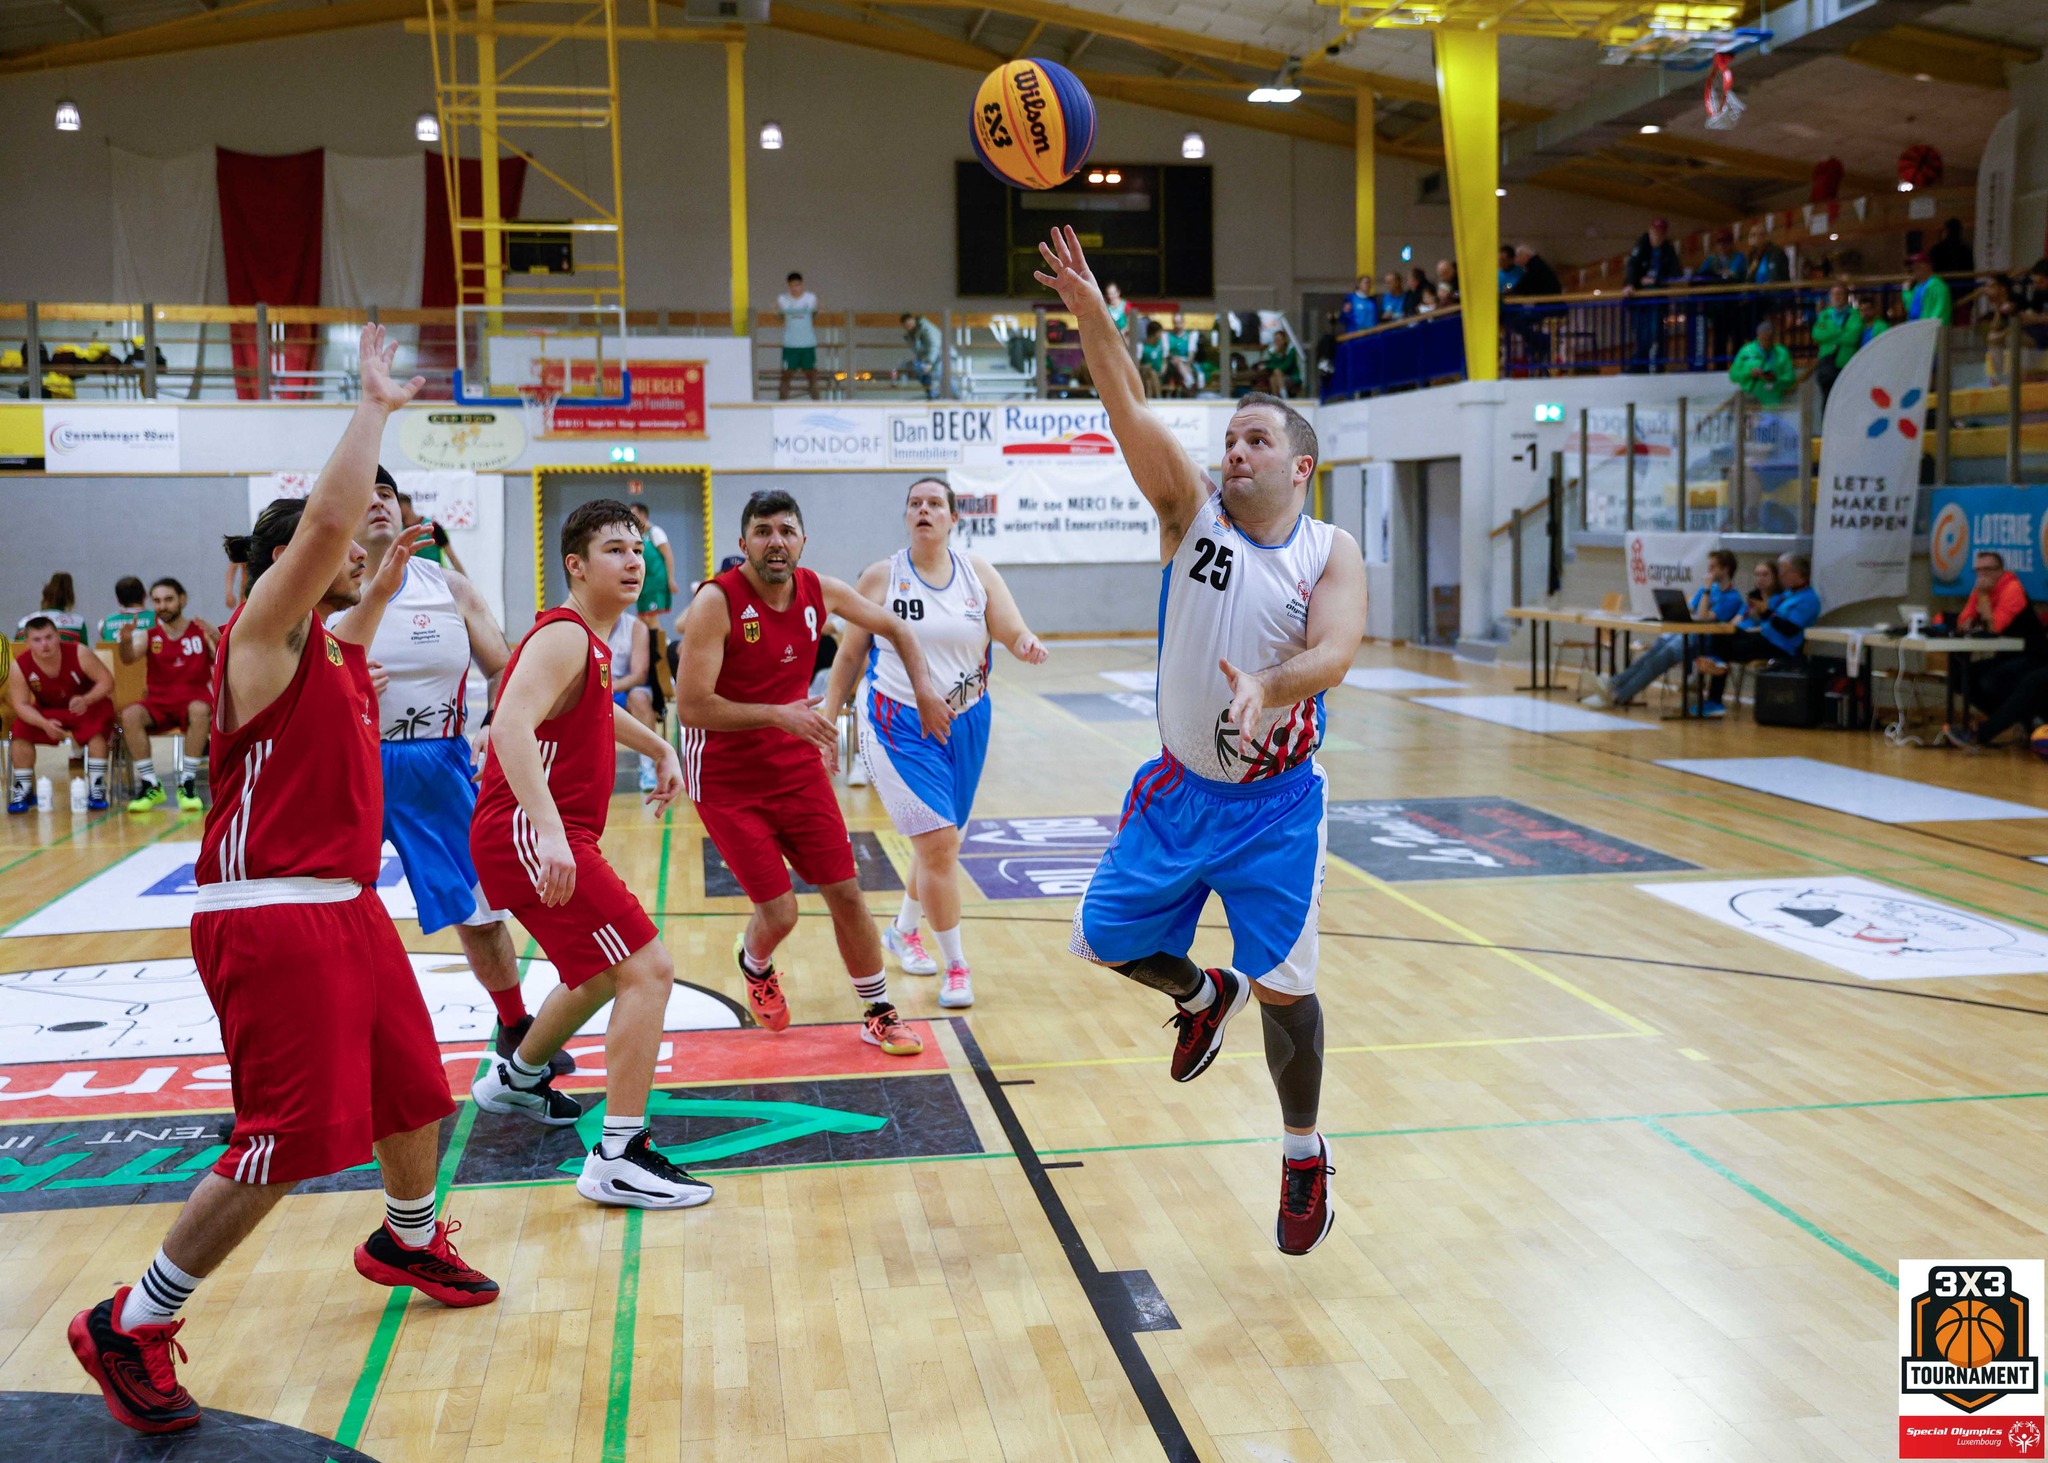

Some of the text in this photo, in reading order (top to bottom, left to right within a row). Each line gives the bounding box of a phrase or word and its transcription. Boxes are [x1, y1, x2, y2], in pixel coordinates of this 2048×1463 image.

[1014, 69, 1050, 158] Wilson
[893, 411, 993, 443] Dan BECK
[1006, 407, 1109, 436] Ruppert
[774, 436, 882, 453] MONDORF
[1833, 476, 1886, 492] LET'S
[1018, 498, 1038, 510] Mir
[1068, 497, 1106, 511] MERCI
[1831, 496, 1912, 512] MAKE IT
[1830, 515, 1908, 530] HAPPEN
[1973, 513, 2033, 546] LOTERIE
[1189, 537, 1234, 591] 25
[1647, 562, 1693, 585] cargolux
[893, 599, 924, 621] 99
[804, 606, 817, 642] 9
[180, 638, 203, 656] 30
